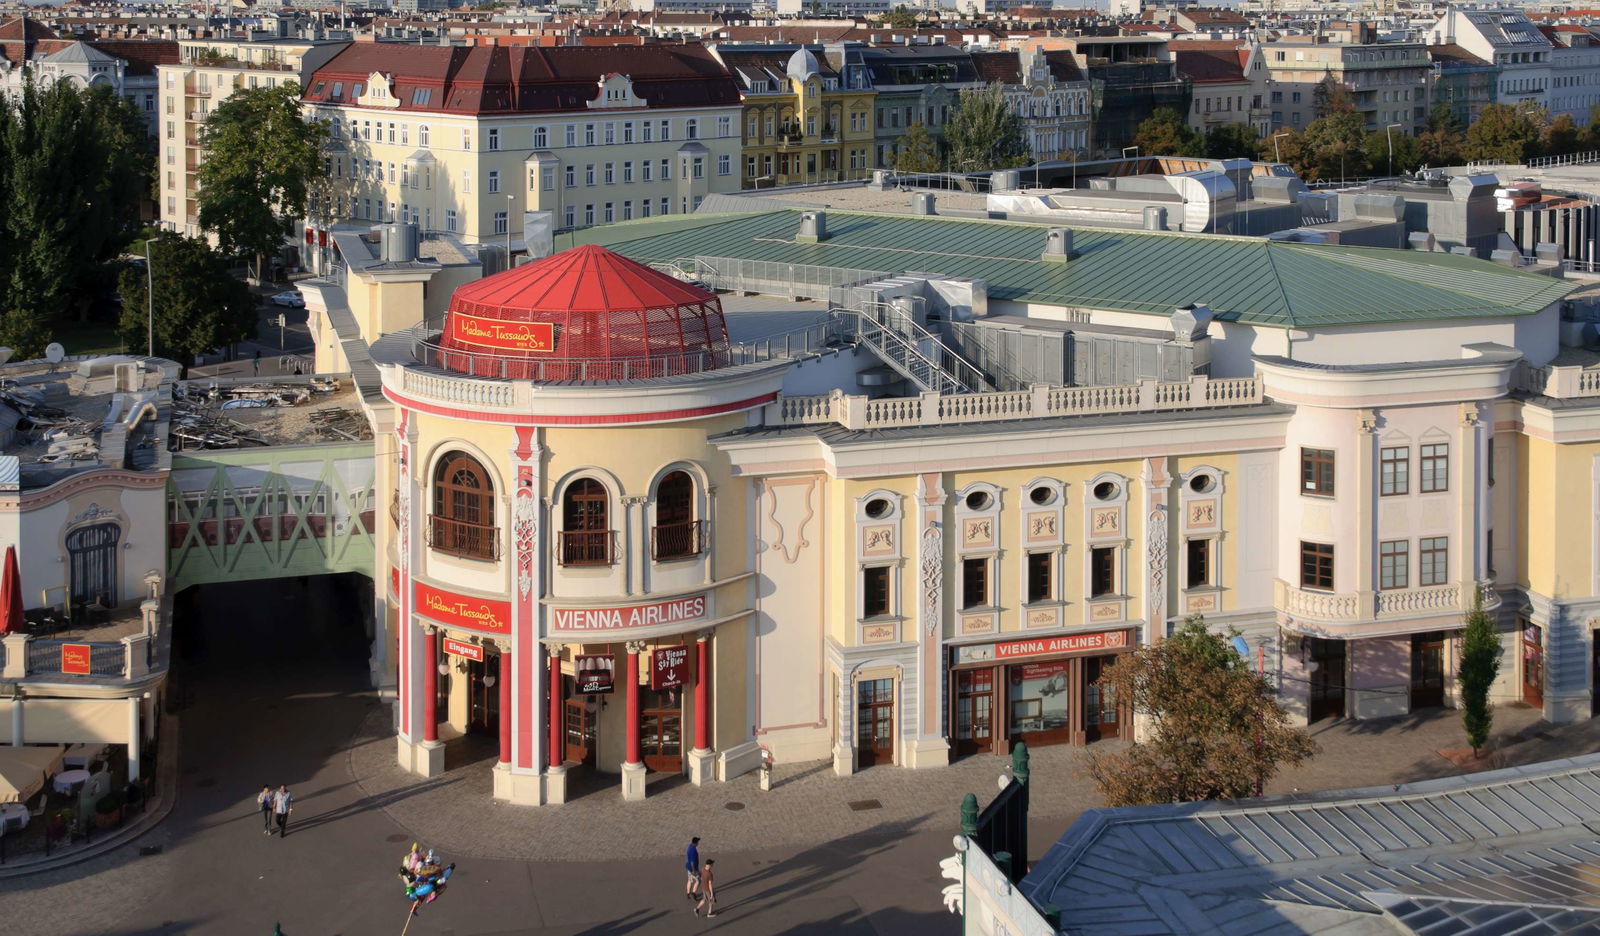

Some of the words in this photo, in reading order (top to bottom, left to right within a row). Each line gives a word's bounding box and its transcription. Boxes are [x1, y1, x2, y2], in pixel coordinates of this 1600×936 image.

[461, 319, 494, 338] Madame
[491, 325, 538, 348] Tussauds
[426, 593, 458, 614] Madame
[455, 603, 498, 628] Tussauds
[555, 610, 624, 629] VIENNA
[628, 597, 704, 626] AIRLINES
[448, 642, 478, 657] Eingang
[665, 649, 687, 660] Vienna
[999, 642, 1044, 655] VIENNA
[1049, 635, 1102, 650] AIRLINES
[670, 657, 684, 667] Ride
